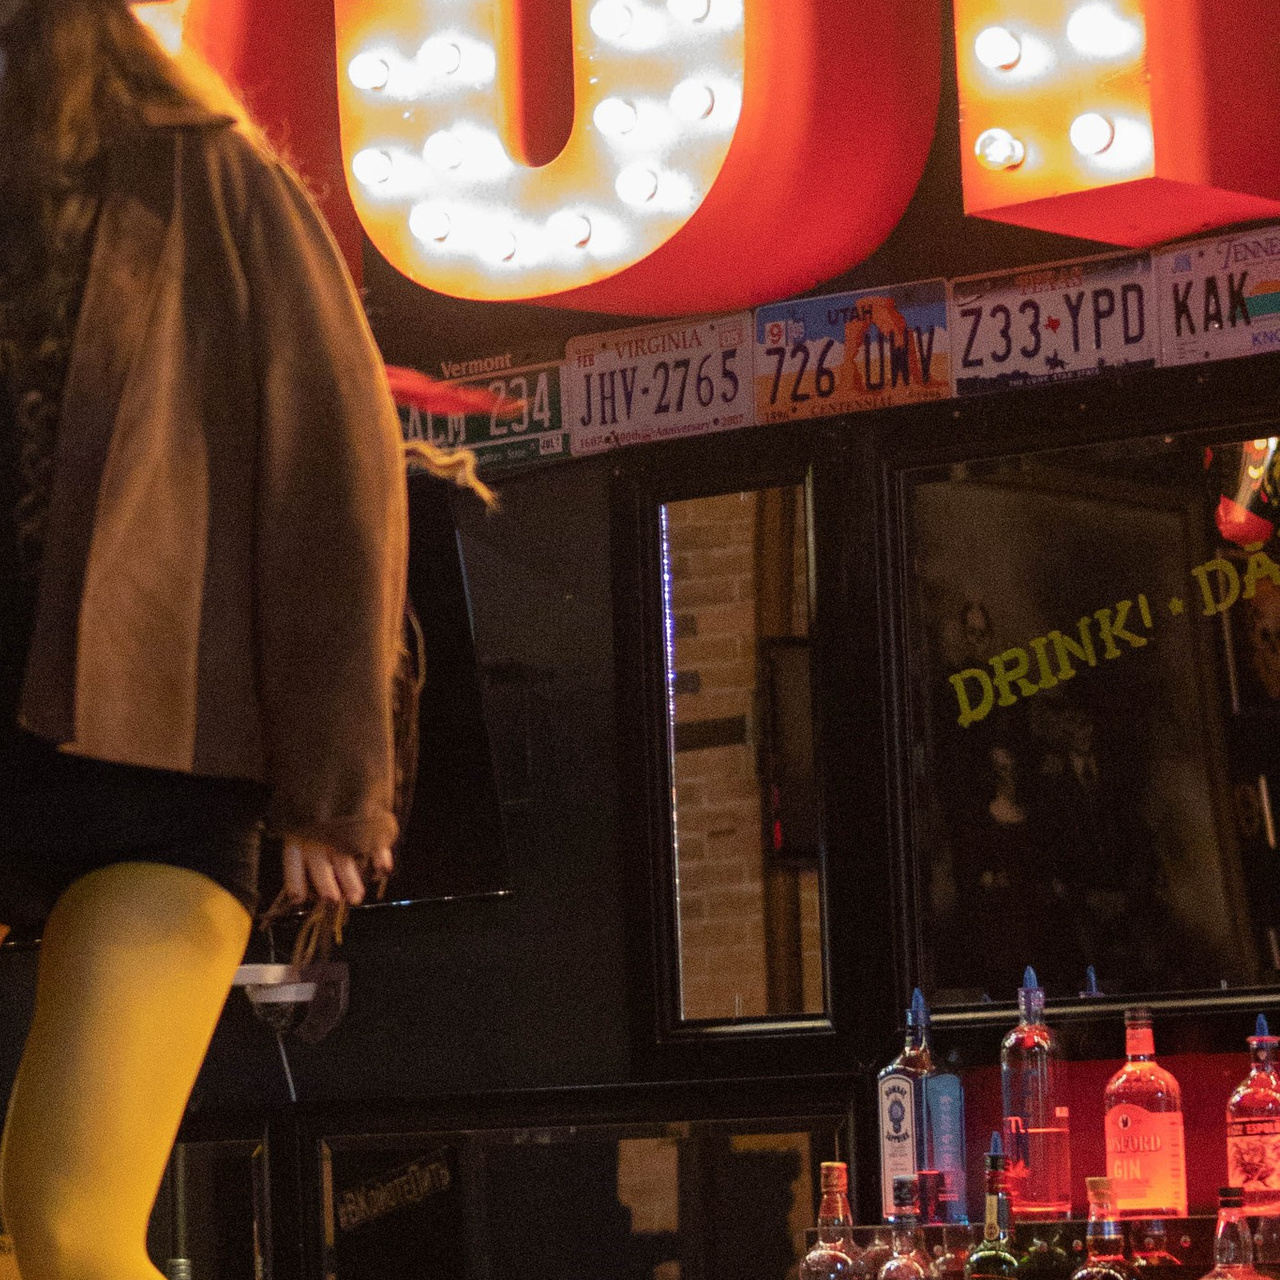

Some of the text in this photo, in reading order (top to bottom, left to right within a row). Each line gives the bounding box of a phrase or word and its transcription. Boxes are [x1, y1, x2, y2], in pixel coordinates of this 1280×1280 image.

[827, 304, 873, 326] UTAH
[960, 282, 1145, 369] Z33 YPD
[1172, 270, 1251, 337] KAK
[441, 353, 512, 379] Vermont
[614, 329, 702, 360] VIRGINIA
[766, 339, 835, 405] 726
[948, 593, 1153, 728] DRINK!
[1114, 1159, 1142, 1181] GIN
